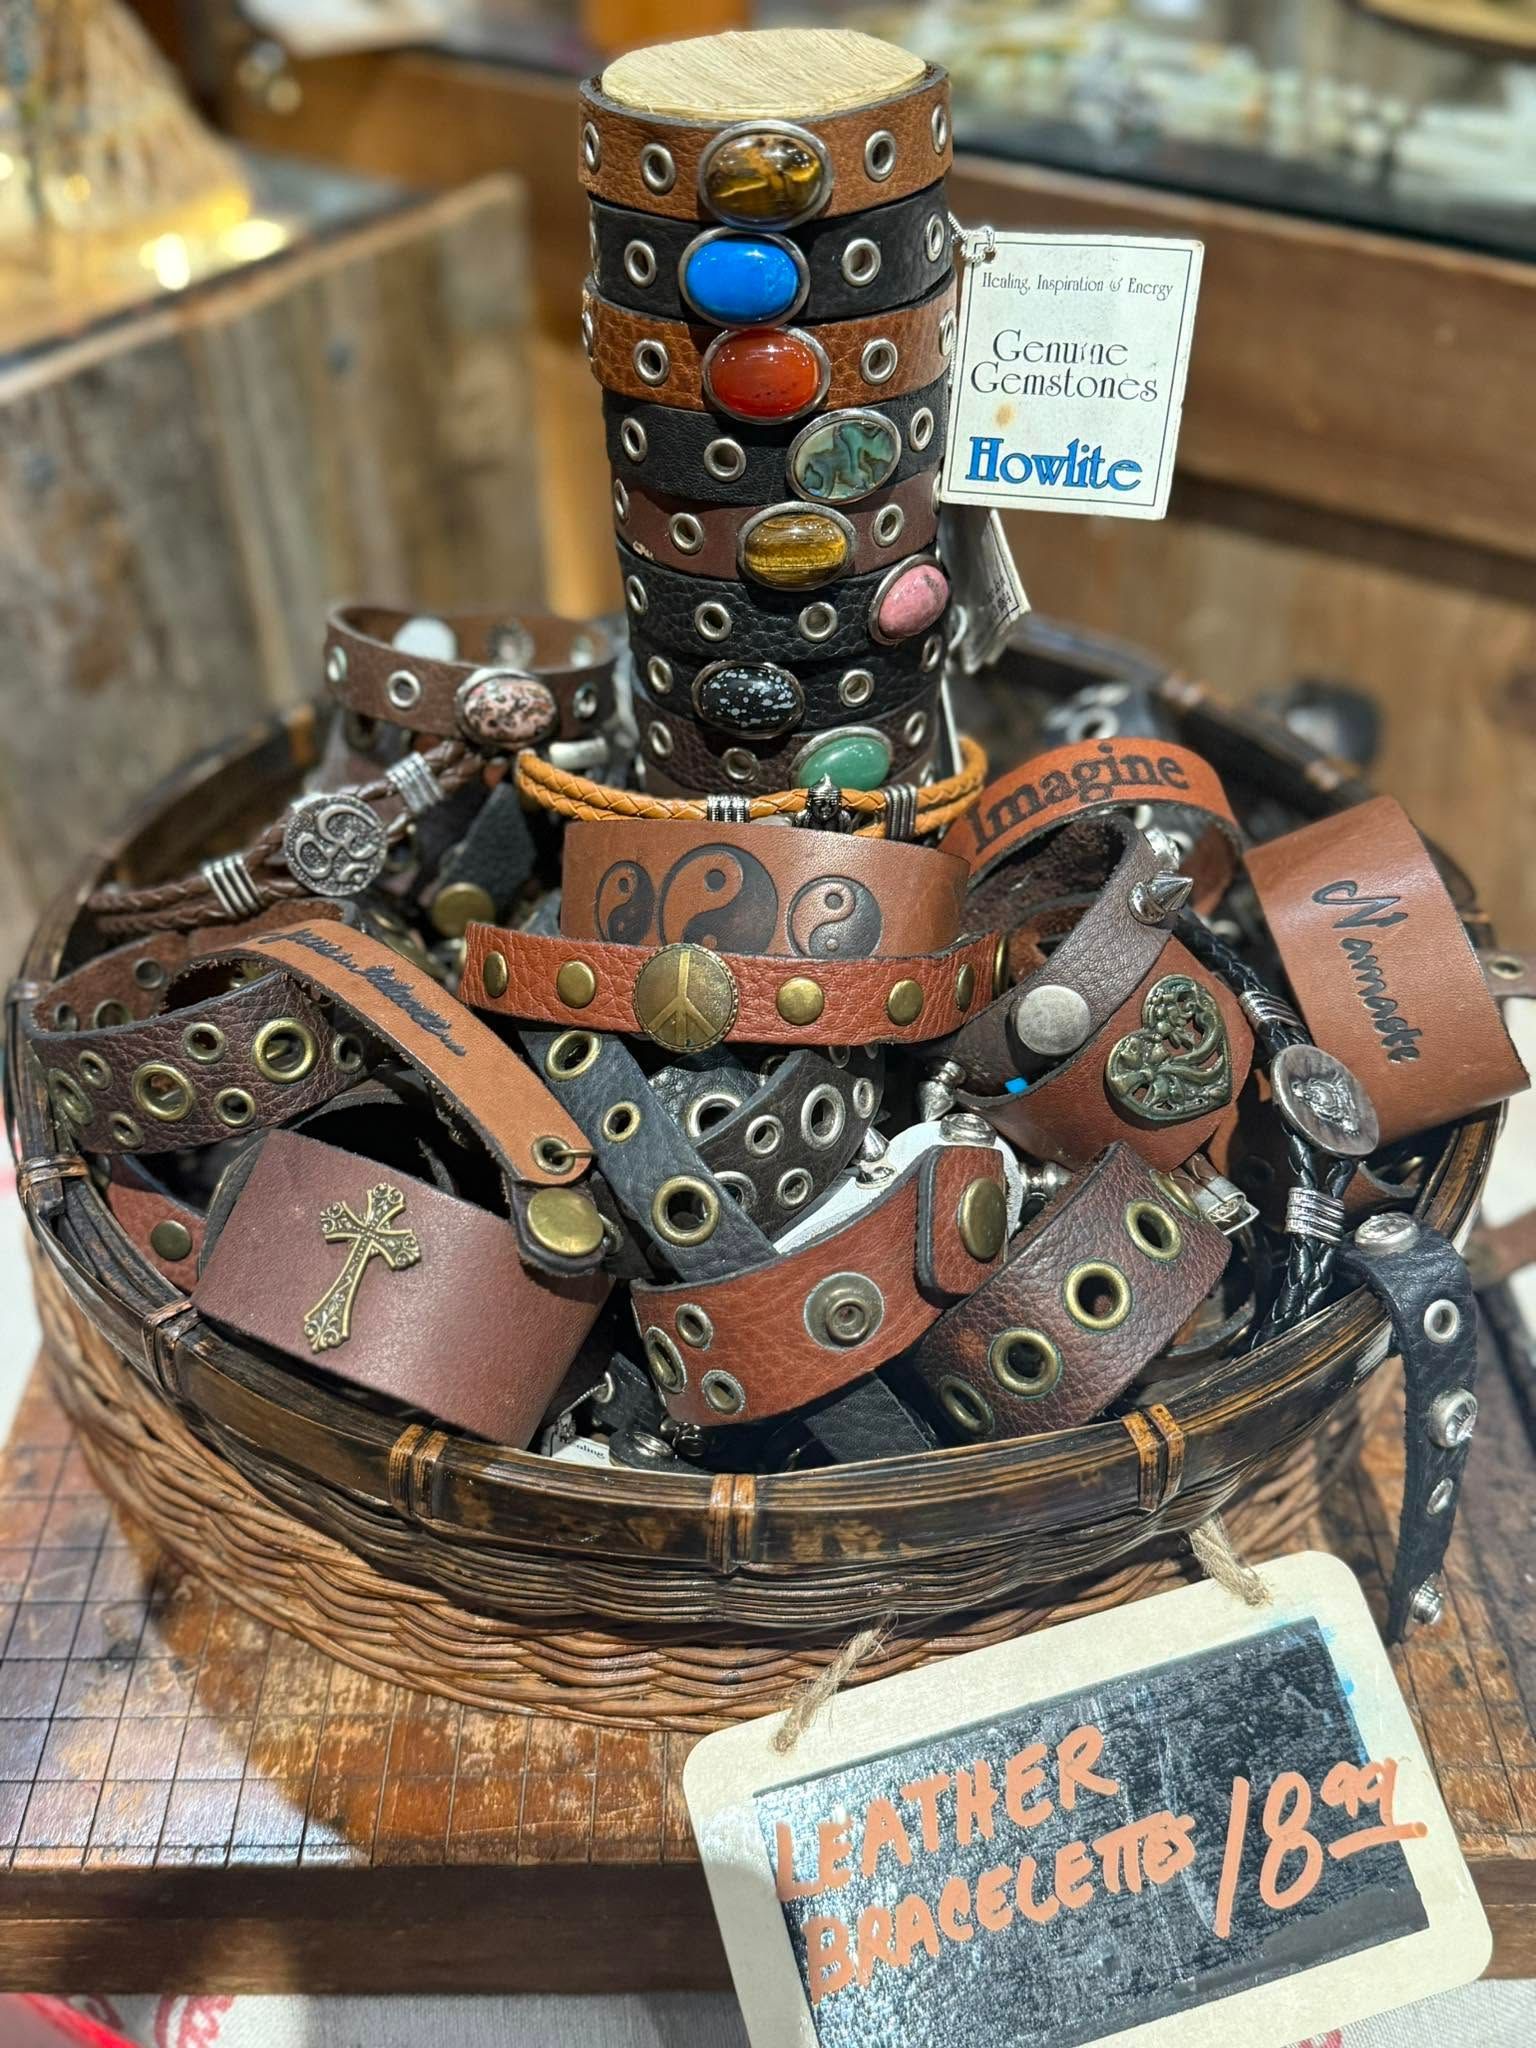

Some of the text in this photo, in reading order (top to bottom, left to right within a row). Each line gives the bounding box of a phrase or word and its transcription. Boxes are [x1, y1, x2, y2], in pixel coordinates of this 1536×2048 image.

[982, 272, 1031, 295] Healing,
[1037, 274, 1104, 295] Inspiration
[1128, 277, 1174, 301] Energy
[993, 329, 1128, 366] Genuine
[970, 361, 1158, 402] Gemstones
[965, 436, 1143, 491] Howlite
[966, 744, 1189, 854] Imagine
[1311, 879, 1424, 1065] Namaste
[775, 1725, 1119, 1904] LEATHER
